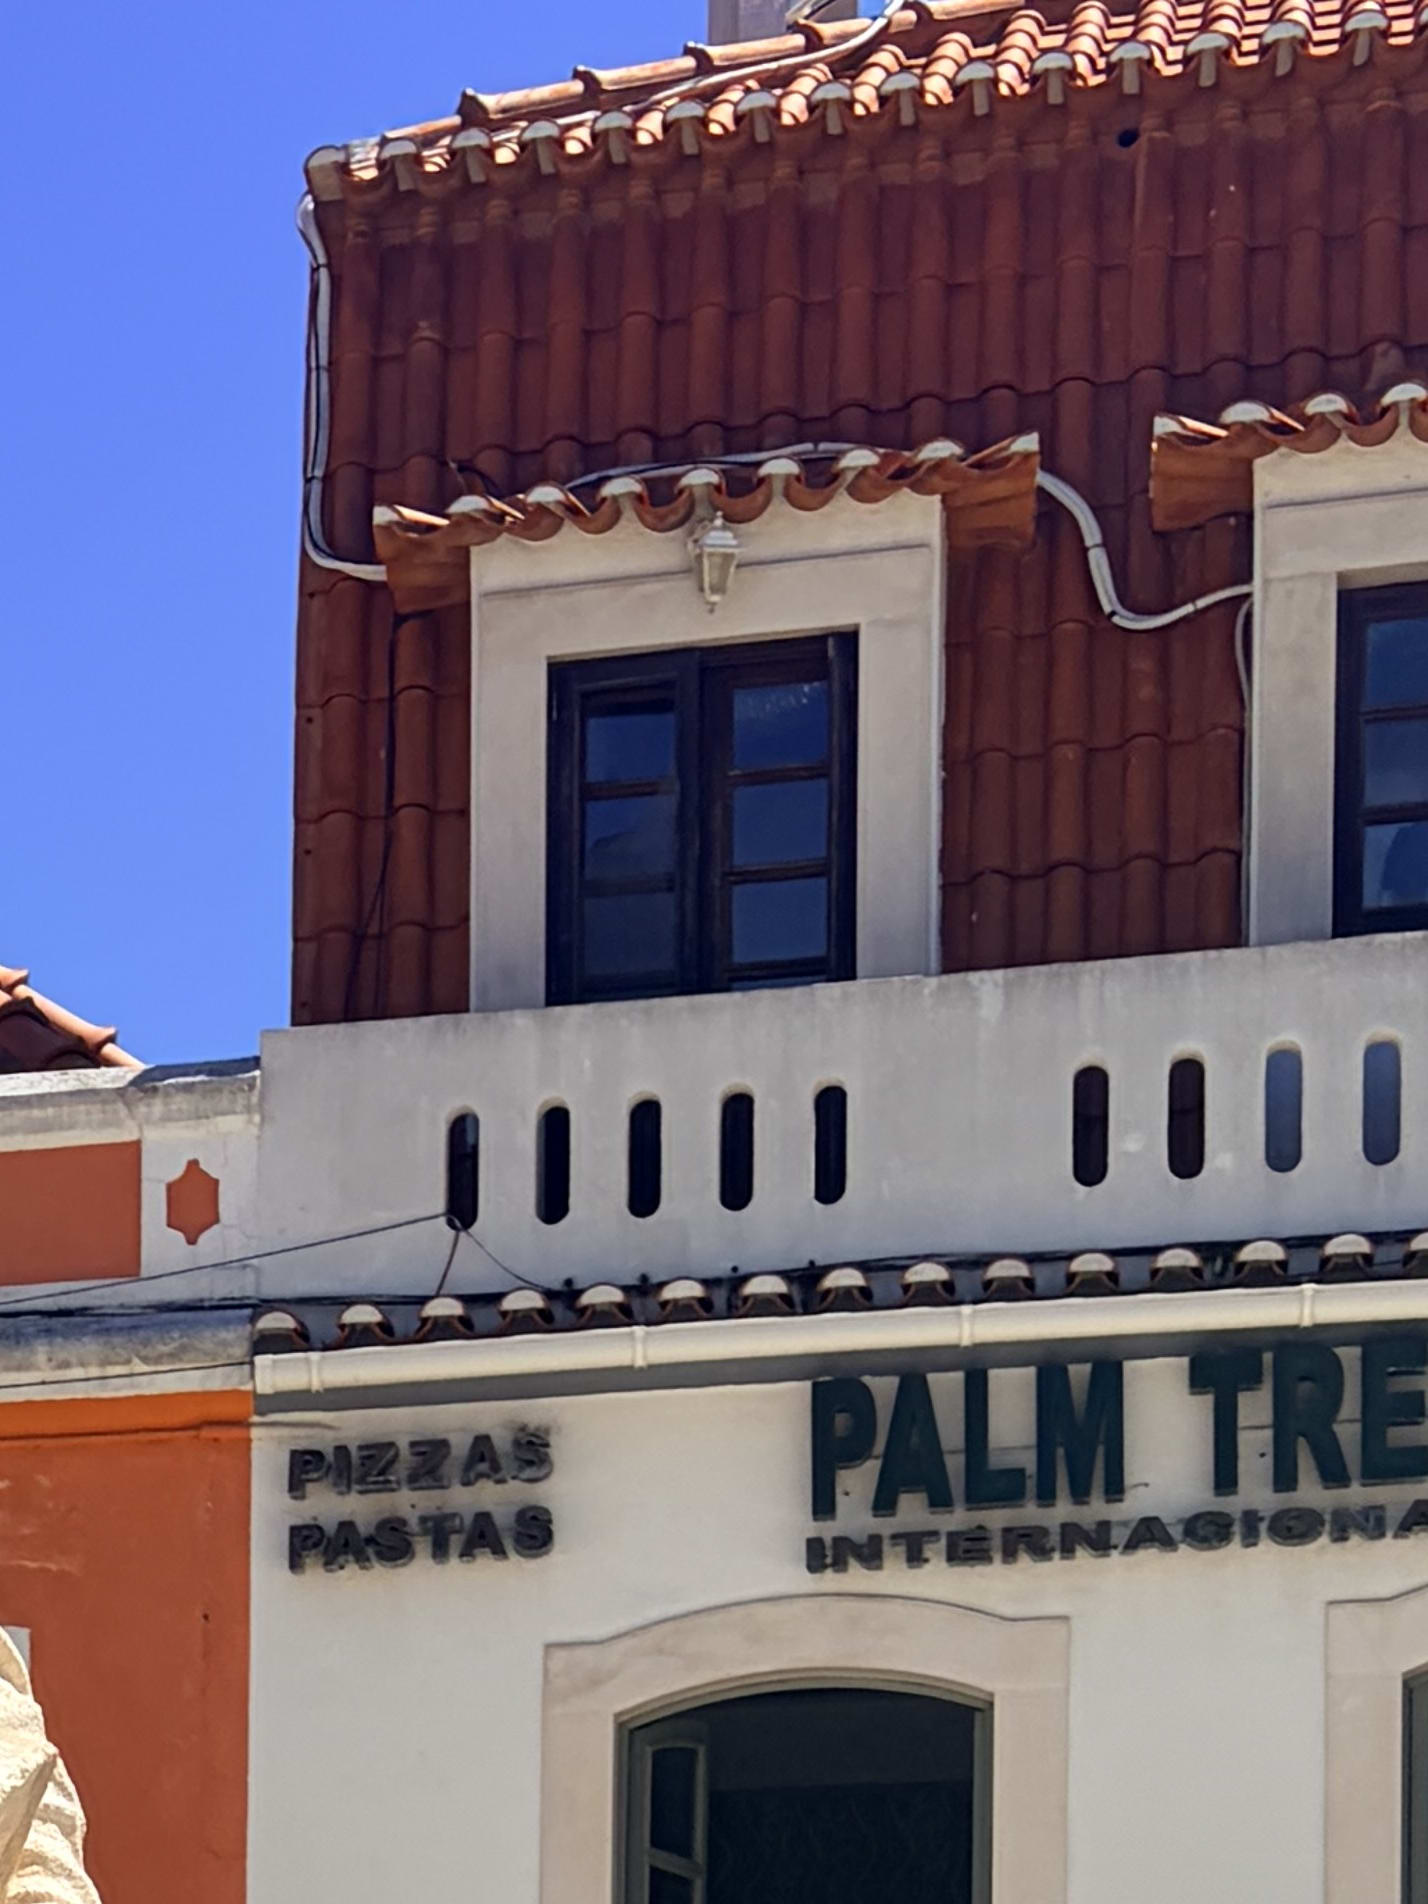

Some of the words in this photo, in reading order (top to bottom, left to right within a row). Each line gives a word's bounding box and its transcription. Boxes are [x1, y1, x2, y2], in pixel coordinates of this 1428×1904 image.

[812, 1359, 1125, 1520] PALM
[1189, 1339, 1428, 1497] TRE
[288, 1432, 554, 1500] PIZZAS
[288, 1505, 554, 1574] PASTAS
